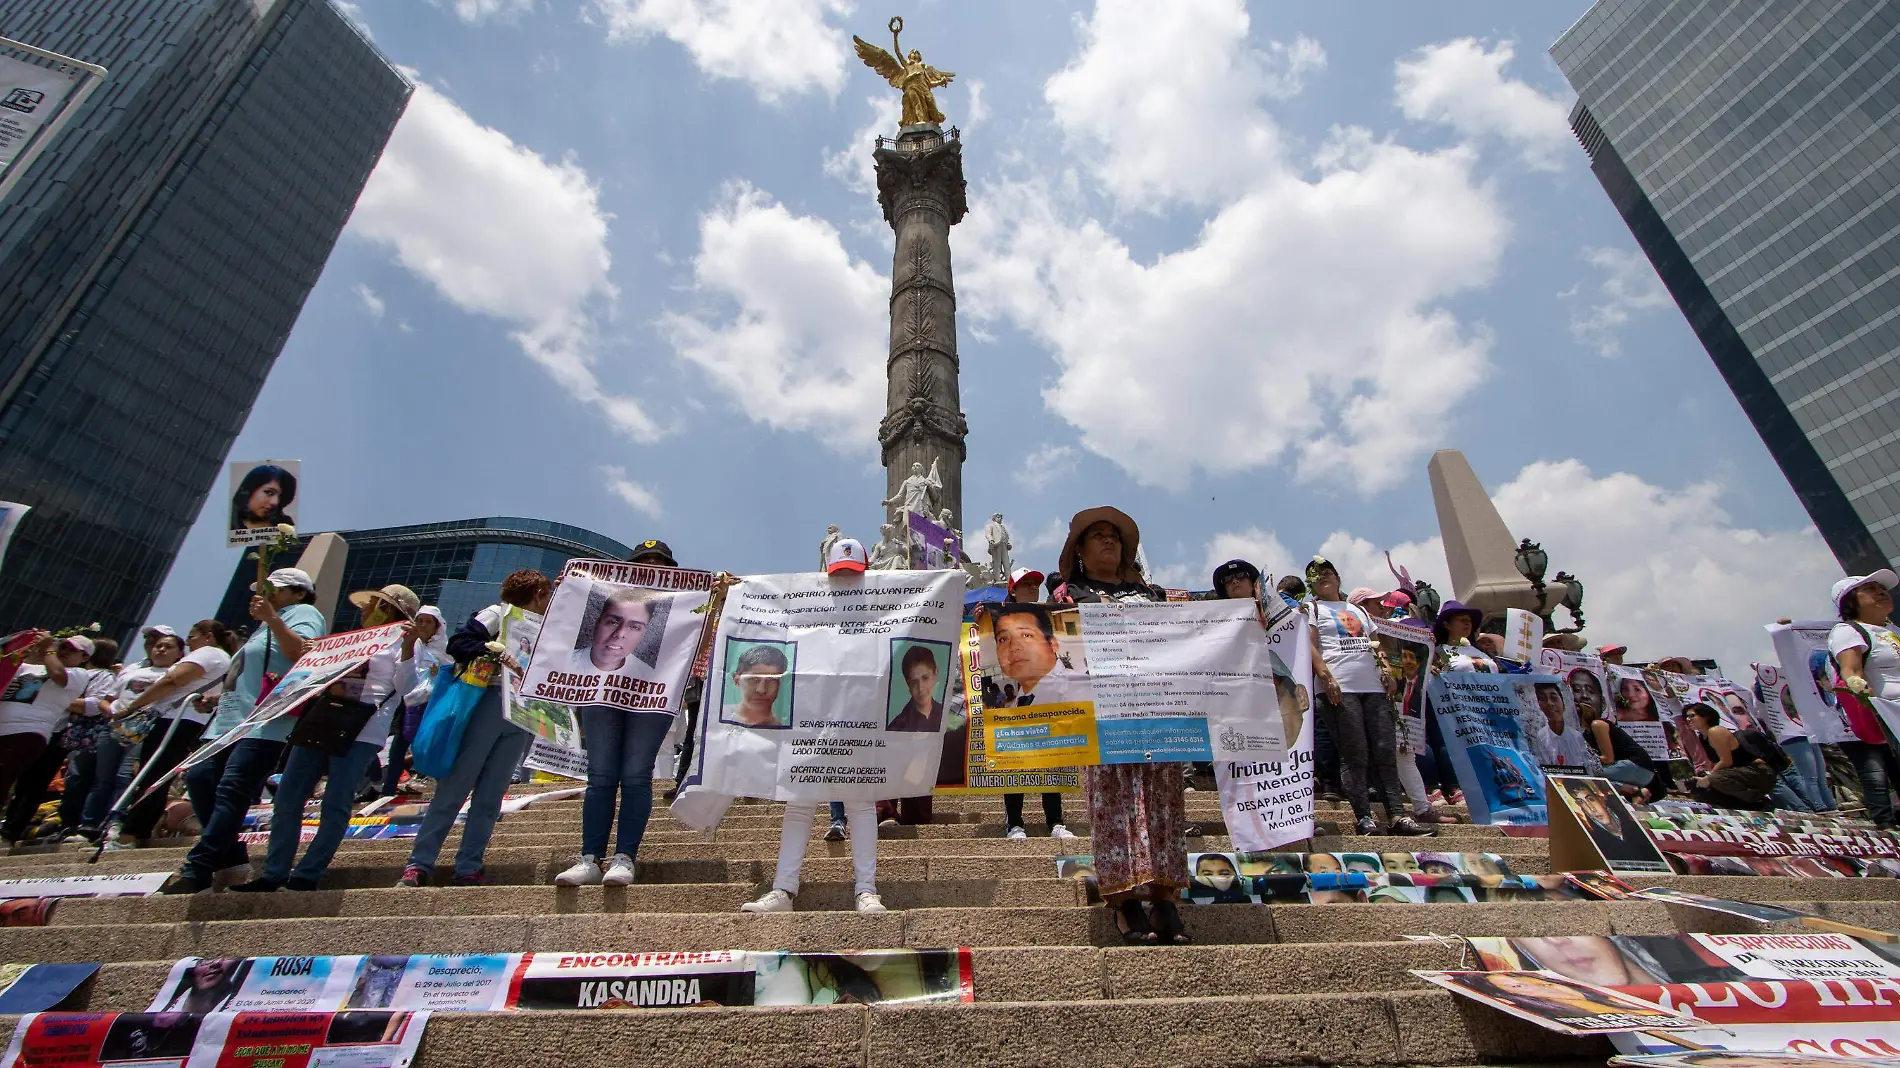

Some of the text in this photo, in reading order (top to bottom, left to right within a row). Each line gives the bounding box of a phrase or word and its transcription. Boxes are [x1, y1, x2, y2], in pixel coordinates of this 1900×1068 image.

[592, 563, 614, 582] QUE
[616, 565, 629, 584] TE
[628, 567, 656, 587] AMO
[658, 570, 671, 588] TE
[672, 572, 711, 591] BUSCO
[742, 586, 933, 600] Nombre: PORFIRIO ADRIAN GALVAN PEREZ
[741, 604, 766, 613] Fecha
[782, 605, 836, 616] desaparición:
[843, 604, 853, 612] 16
[856, 604, 868, 612] DE
[870, 604, 901, 612] ENERO
[904, 601, 921, 610] DEL
[923, 600, 945, 609] 2012
[902, 615, 937, 625] ESTADO
[854, 626, 891, 635] MEXICO
[547, 671, 666, 696] CARLOS ALBERTO
[535, 681, 667, 709] SÁNCHEZ TOSCANO
[1440, 693, 1509, 704] 29 2022
[994, 707, 1085, 722] Persona desaparecida
[1437, 703, 1519, 716] CALLE CUADRO
[800, 719, 878, 729] SEÑAS PARTICULARES
[996, 729, 1010, 738] ¿La
[1011, 728, 1024, 736] has
[1026, 726, 1048, 735] visto?
[839, 739, 872, 747] BARBILLA
[875, 740, 886, 748] DEL
[1041, 736, 1085, 747] encontrarla
[792, 747, 853, 756] LADO IZQUIERDO
[791, 765, 886, 775] CICATRIZ EN CEJA DERECHA
[790, 775, 886, 784] Y LABIO INFERIOR DERECHO
[970, 772, 1042, 788] NÚMERO DE CASO:
[1237, 786, 1314, 812] DESAPARECID
[1261, 811, 1274, 822] 17
[1288, 804, 1303, 816] 08
[1269, 813, 1314, 831] Monterre
[557, 950, 732, 969] ENCONTRARLA
[270, 956, 316, 977] ROSA
[444, 980, 461, 988] Julio
[475, 979, 491, 987] 2017
[578, 978, 702, 1008] KASANDRA
[264, 999, 282, 1007] Junio
